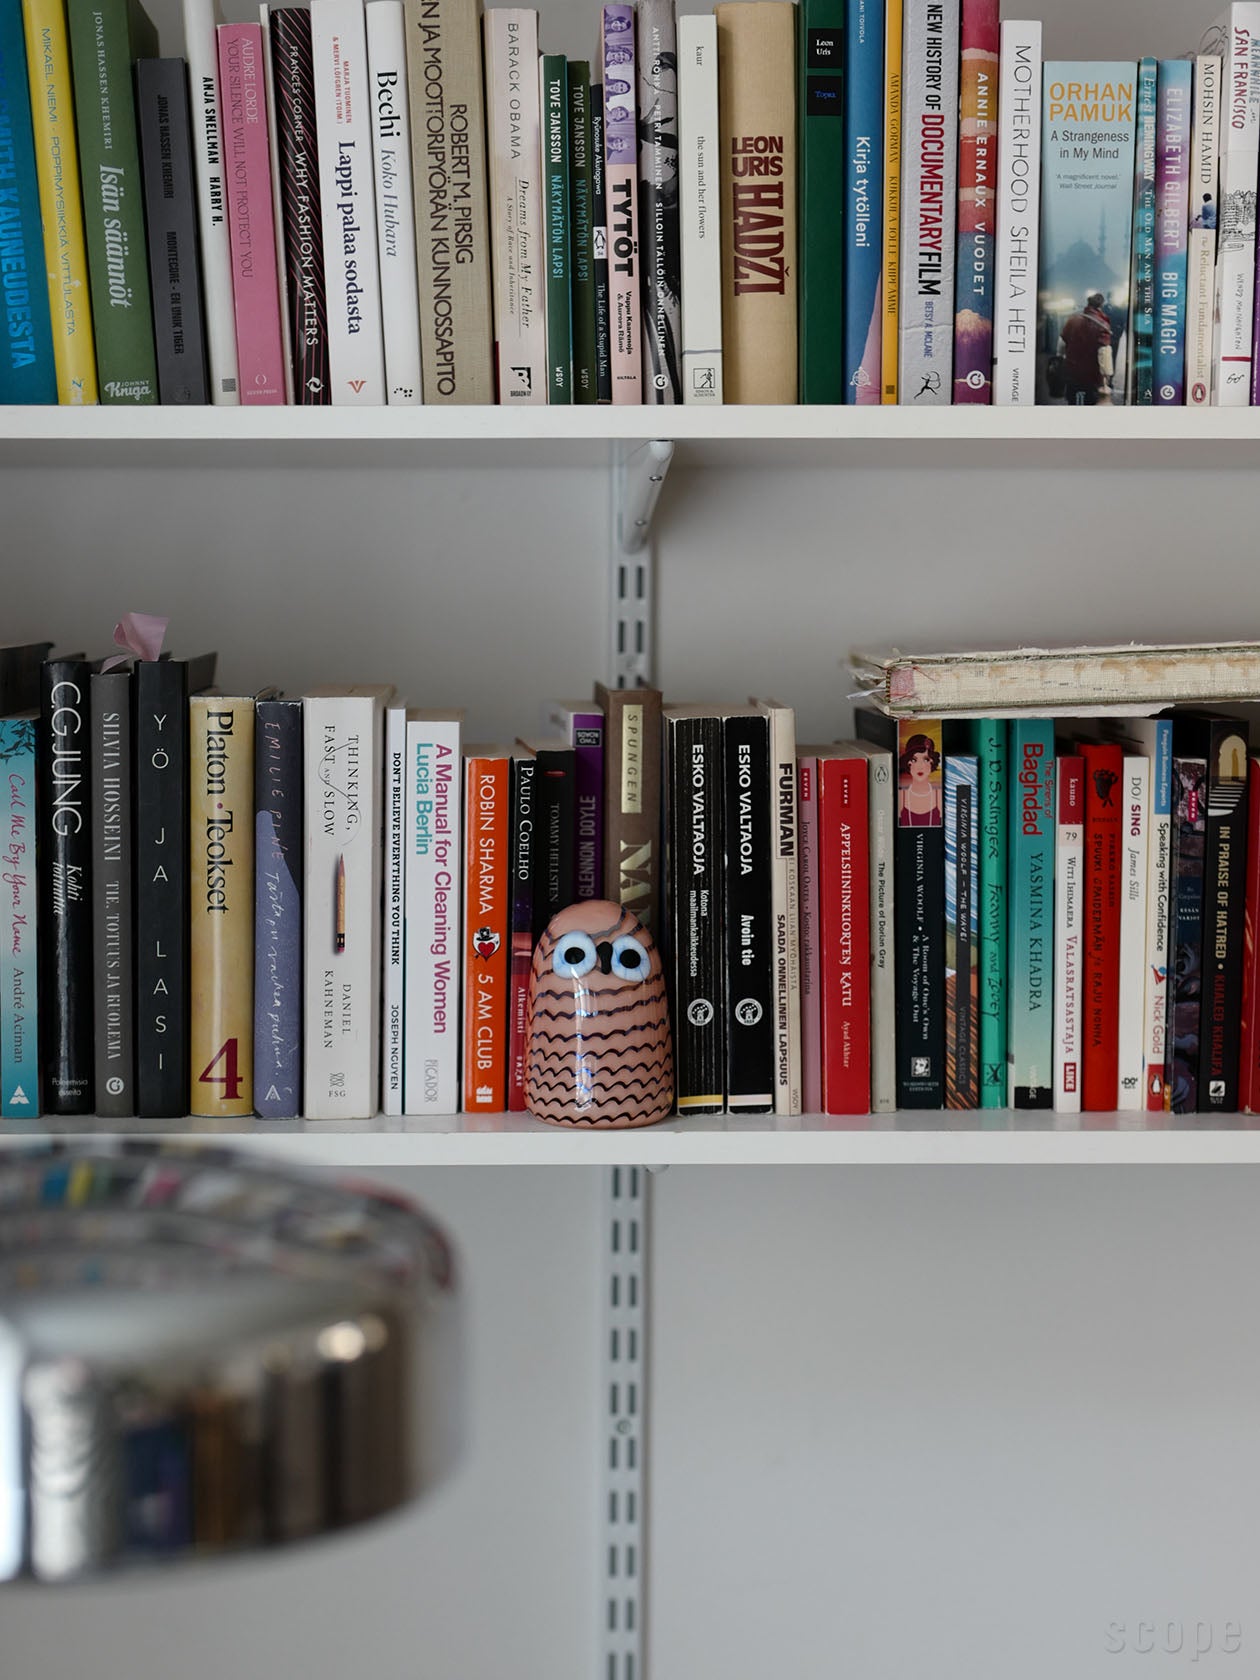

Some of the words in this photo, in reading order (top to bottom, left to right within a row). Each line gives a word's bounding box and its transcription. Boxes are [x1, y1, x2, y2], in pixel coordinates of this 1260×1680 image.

[417, 22, 442, 44] JA
[816, 39, 833, 47] Leon
[1234, 27, 1250, 56] SAN
[241, 38, 254, 80] AUDRE
[507, 23, 520, 92] BARACK
[202, 77, 214, 104] ANJA
[244, 83, 258, 124] LORDE
[377, 71, 401, 138] Bechi
[550, 79, 560, 107] TOVE
[977, 73, 988, 127] ANNIE
[1050, 83, 1132, 101] ORHAN
[1050, 103, 1133, 121] PAMUK
[1203, 63, 1214, 126] MOHSIN
[1232, 62, 1248, 129] FRANCISCO
[204, 108, 220, 164] SNELLMAN
[423, 48, 452, 232] MOOTTORIPYÖRÄN
[450, 104, 470, 178] ROBERT
[509, 100, 521, 160] OBAMA
[550, 112, 562, 163] JANSSON
[696, 136, 705, 150] the
[732, 136, 783, 154] LEON
[1011, 45, 1031, 213] MOTHERHOOD
[1052, 131, 1058, 142] A
[1062, 131, 1129, 144] Strangeness
[1166, 88, 1182, 176] ELIZABETH
[294, 152, 307, 188] WHY
[334, 140, 358, 198] Lappi
[380, 149, 398, 190] Koko
[594, 154, 603, 194] Akutagawa
[697, 154, 705, 170] sun
[732, 157, 783, 177] URIS
[853, 136, 870, 174] Kirja
[976, 137, 987, 208] ERNAUX
[1060, 148, 1069, 158] in
[1072, 148, 1088, 161] My
[1090, 147, 1119, 159] Mind
[1200, 132, 1212, 184] HAMID
[41, 28, 52, 82] MIKAEL
[47, 85, 58, 122] NIEMI
[61, 251, 76, 336] VITTULASTA
[99, 164, 125, 213] Isän
[209, 177, 222, 210] HARRY
[452, 181, 471, 202] M.
[698, 172, 706, 188] and
[698, 190, 706, 204] her
[212, 214, 224, 226] H.
[518, 179, 530, 226] Dreams
[550, 174, 564, 246] NÄKYMÄTÖN
[655, 202, 663, 242] SILLOIN
[698, 204, 706, 240] flowers
[853, 179, 871, 248] työlleni
[1163, 180, 1181, 249] GILBERT
[299, 195, 312, 268] FASHION
[336, 202, 362, 256] palaa
[382, 194, 400, 257] Hubara
[454, 207, 475, 264] PIRSIG
[517, 228, 531, 259] from
[612, 178, 638, 277] TYTÖT
[733, 182, 790, 296] HADŽI
[0, 187, 36, 370] KAUNEUDESTA
[104, 218, 131, 307] säännöt
[518, 263, 531, 282] My
[552, 248, 564, 280] LAPSI
[655, 246, 663, 287] TÄLLÖIN
[973, 222, 985, 295] VUODET
[1010, 227, 1028, 299] SHEILA
[344, 260, 362, 335] sodasta
[521, 286, 531, 328] Father
[1162, 272, 1177, 303] BIG
[303, 275, 318, 346] MATTERS
[430, 237, 456, 396] KUNNOSSAPITO
[656, 291, 665, 356] ONNELLINEN
[1007, 308, 1025, 353] HETI
[1160, 308, 1176, 354] MAGIC
[103, 712, 120, 769] SILVIA
[206, 710, 233, 795] Platon
[436, 744, 452, 759] A
[627, 715, 638, 801] SPUNGEN
[416, 743, 432, 794] Lucia
[693, 744, 703, 787] ESKO
[8, 774, 26, 808] Call
[392, 786, 400, 831] BELIEVE
[436, 764, 452, 833] Manual
[480, 775, 495, 830] ROBIN
[779, 763, 793, 856] FURMAN
[1020, 743, 1043, 836] Baghdad
[1131, 777, 1141, 801] DO/
[10, 814, 26, 838] Me
[103, 778, 121, 860] HOSSEINI
[416, 801, 432, 855] Berlin
[580, 796, 595, 836] DOYLE
[693, 792, 704, 875] VALTAOJA
[1131, 805, 1141, 837] SING
[1219, 826, 1230, 838] IN
[3, 843, 26, 870] By
[206, 811, 233, 914] Teokset
[392, 833, 400, 902] EVERYTHING
[435, 840, 451, 866] for
[1129, 848, 1139, 878] James
[1156, 823, 1169, 869] Speaking
[1218, 846, 1230, 887] PRAISE
[3, 873, 26, 907] Your
[479, 839, 495, 914] SHARMA
[579, 840, 594, 897] GLENNON
[1129, 878, 1139, 900] Sills
[1159, 872, 1168, 893] with
[431, 872, 451, 955] Cleaning
[700, 890, 709, 916] Kotona
[1030, 852, 1043, 931] YASMINA
[1217, 892, 1228, 907] OF
[10, 914, 27, 957] Name
[392, 904, 400, 926] YOU
[690, 890, 698, 976] maailmankaikkeudessa
[741, 915, 754, 946] Avoin
[777, 914, 786, 954] SAADA
[878, 910, 885, 918] of
[878, 920, 886, 947] Dorian
[1156, 895, 1168, 952] Confidence
[1216, 911, 1227, 958] HATRED
[392, 930, 400, 965] THINK
[741, 949, 755, 965] tie
[877, 950, 886, 968] Gray
[13, 968, 24, 1009] André
[478, 974, 493, 983] 5
[778, 958, 787, 1030] ONNELLINEN
[1029, 938, 1042, 1011] KHADRA
[434, 961, 450, 1033] Women
[478, 991, 493, 1020] AM
[516, 986, 526, 1034] Alkemisti
[1153, 996, 1164, 1020] Nick
[14, 1014, 24, 1063] Aciman
[391, 1005, 399, 1044] JOSEPH
[1153, 1024, 1163, 1054] Gold
[199, 1038, 243, 1099] 4
[477, 1027, 492, 1069] CLUB
[779, 1034, 788, 1086] LAPSUUS
[1065, 1066, 1074, 1089] LIKE
